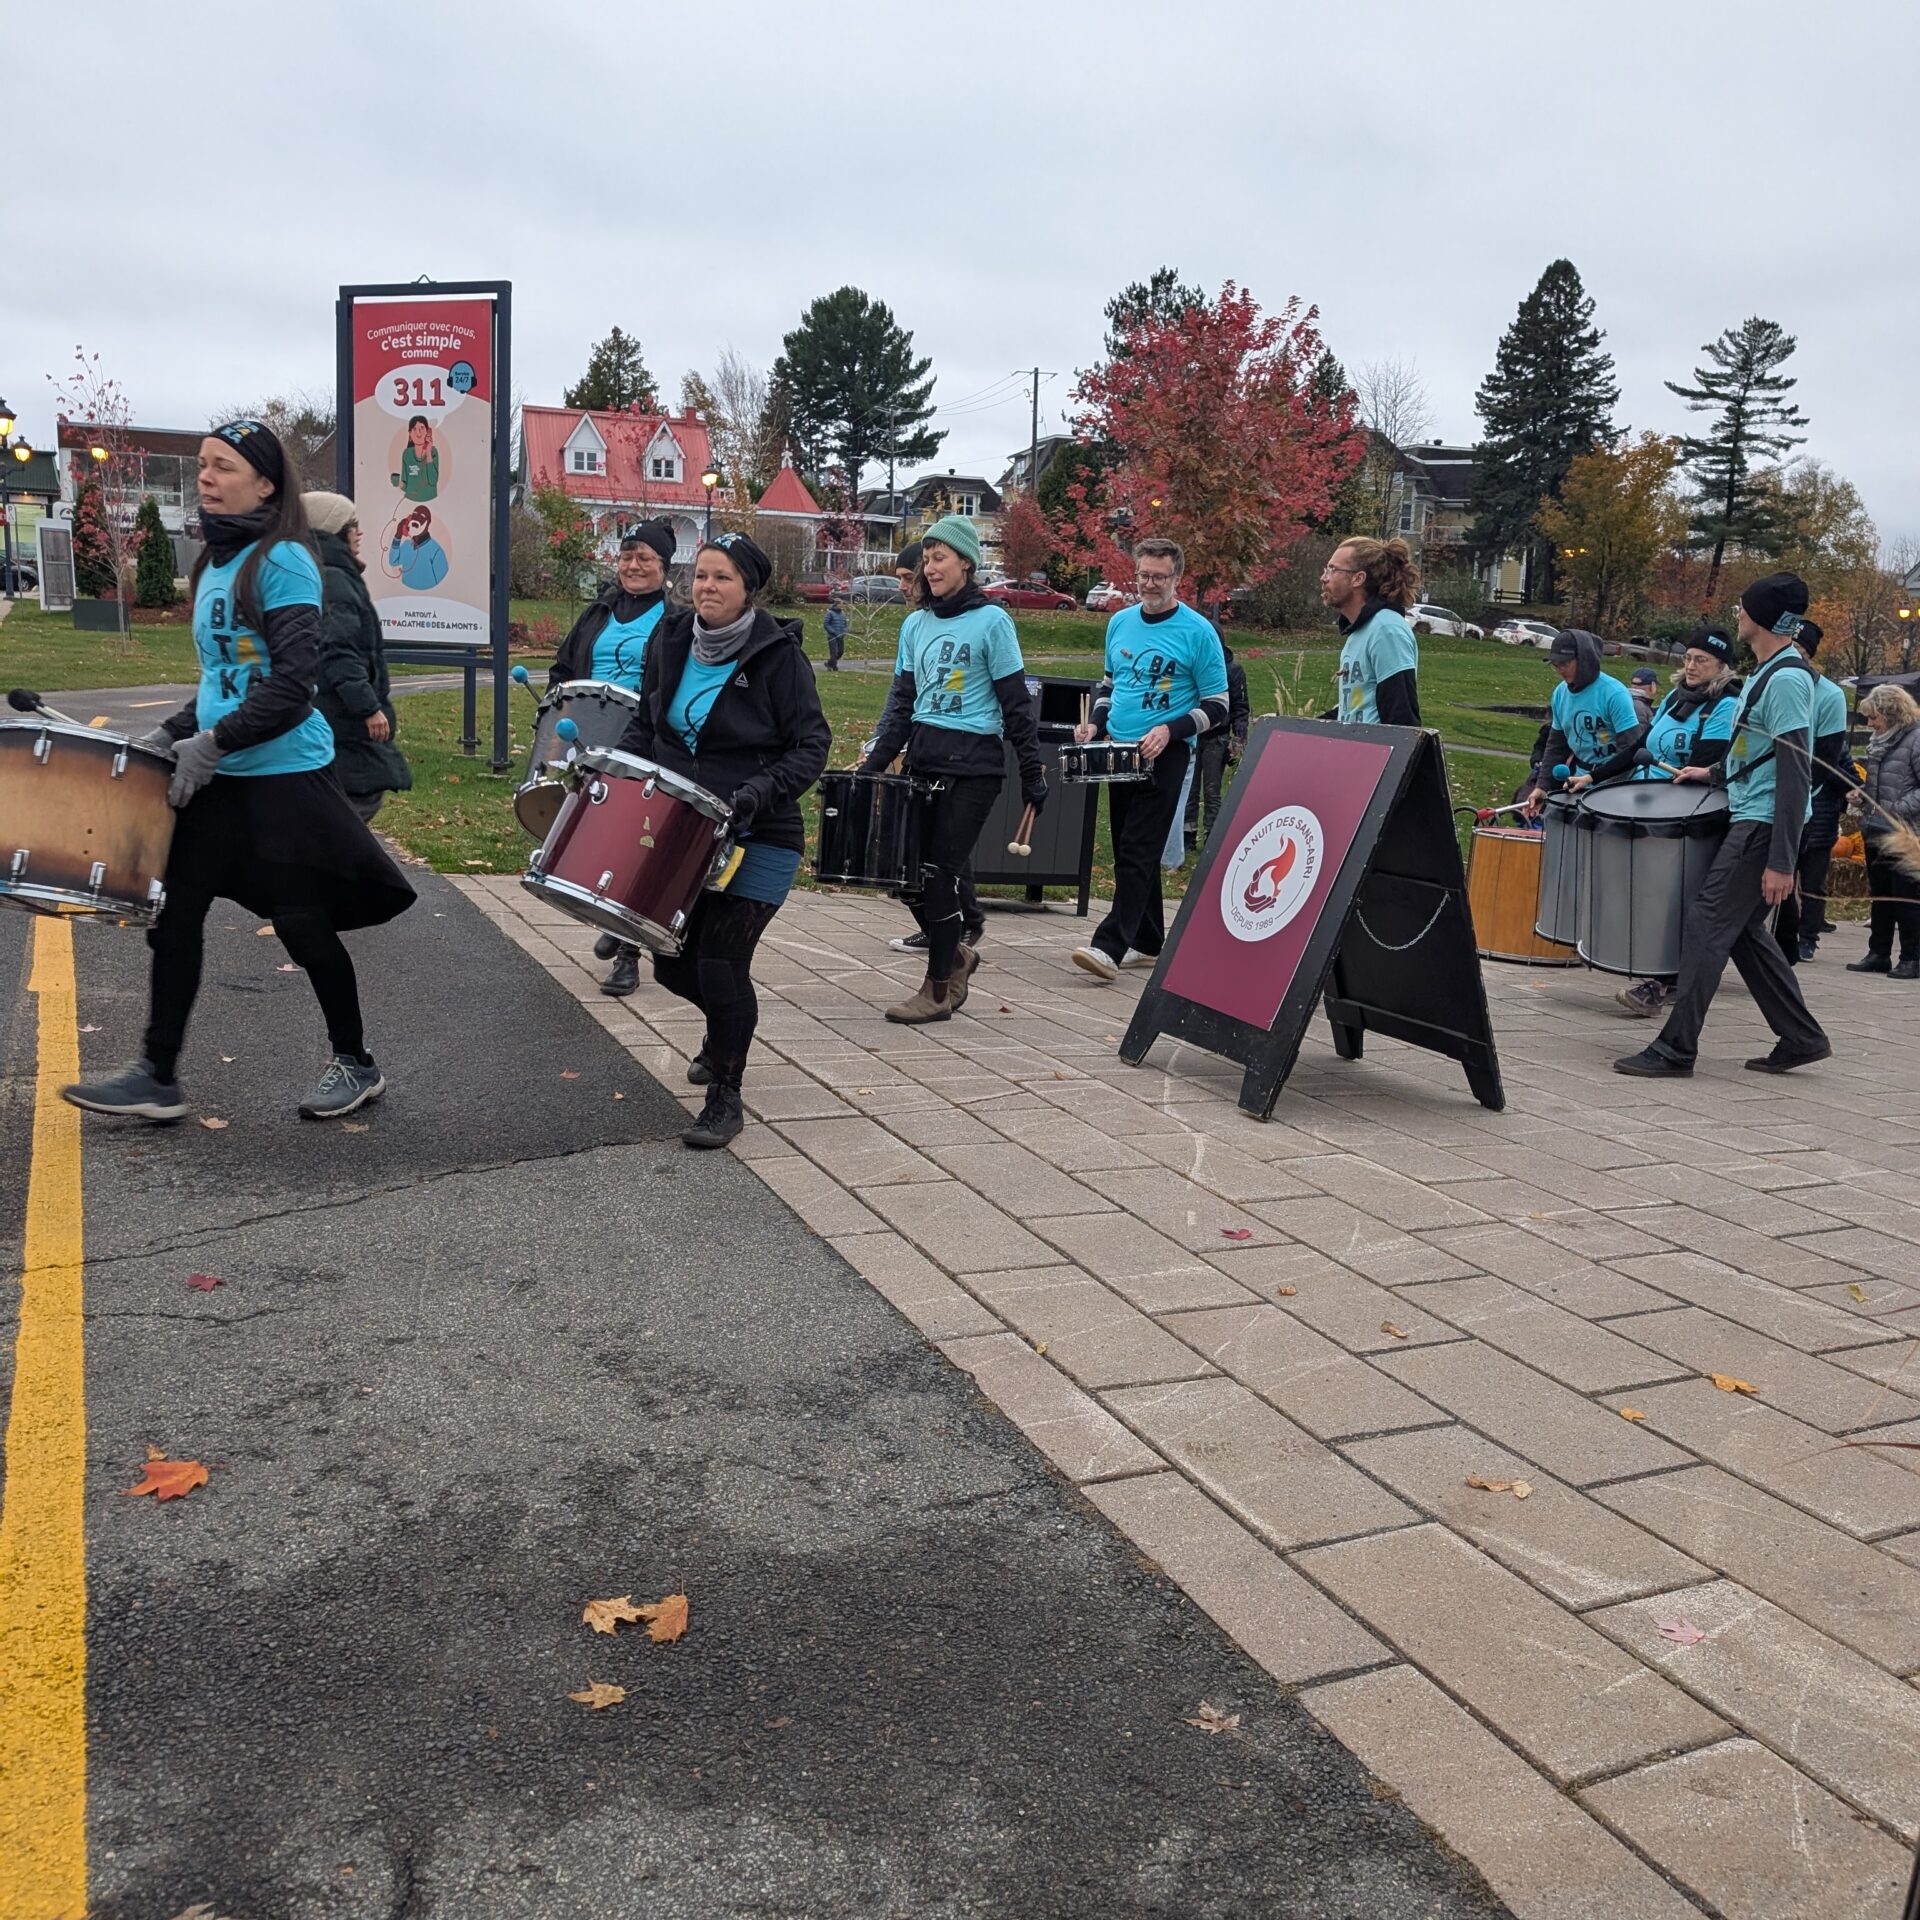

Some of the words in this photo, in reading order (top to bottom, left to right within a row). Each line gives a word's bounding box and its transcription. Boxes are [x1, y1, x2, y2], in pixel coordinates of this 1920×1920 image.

[367, 321, 428, 340] Communiquer
[429, 322, 451, 331] avec
[452, 325, 476, 340] nous,
[381, 333, 412, 351] c'est
[415, 331, 461, 351] simple
[401, 349, 439, 359] comme
[393, 377, 445, 407] 311
[397, 620, 425, 628] AGATHE
[432, 611, 438, 619] À
[938, 641, 971, 667] BA
[1149, 655, 1176, 676] BA
[931, 693, 963, 714] KA
[1142, 692, 1170, 710] KA
[1238, 847, 1252, 862] LA
[1251, 821, 1275, 846] NUIT
[1276, 816, 1296, 828] DES
[1295, 819, 1316, 879] SANS-ABRI
[1230, 906, 1253, 930] DEPUIS
[1255, 917, 1274, 930] 1989
